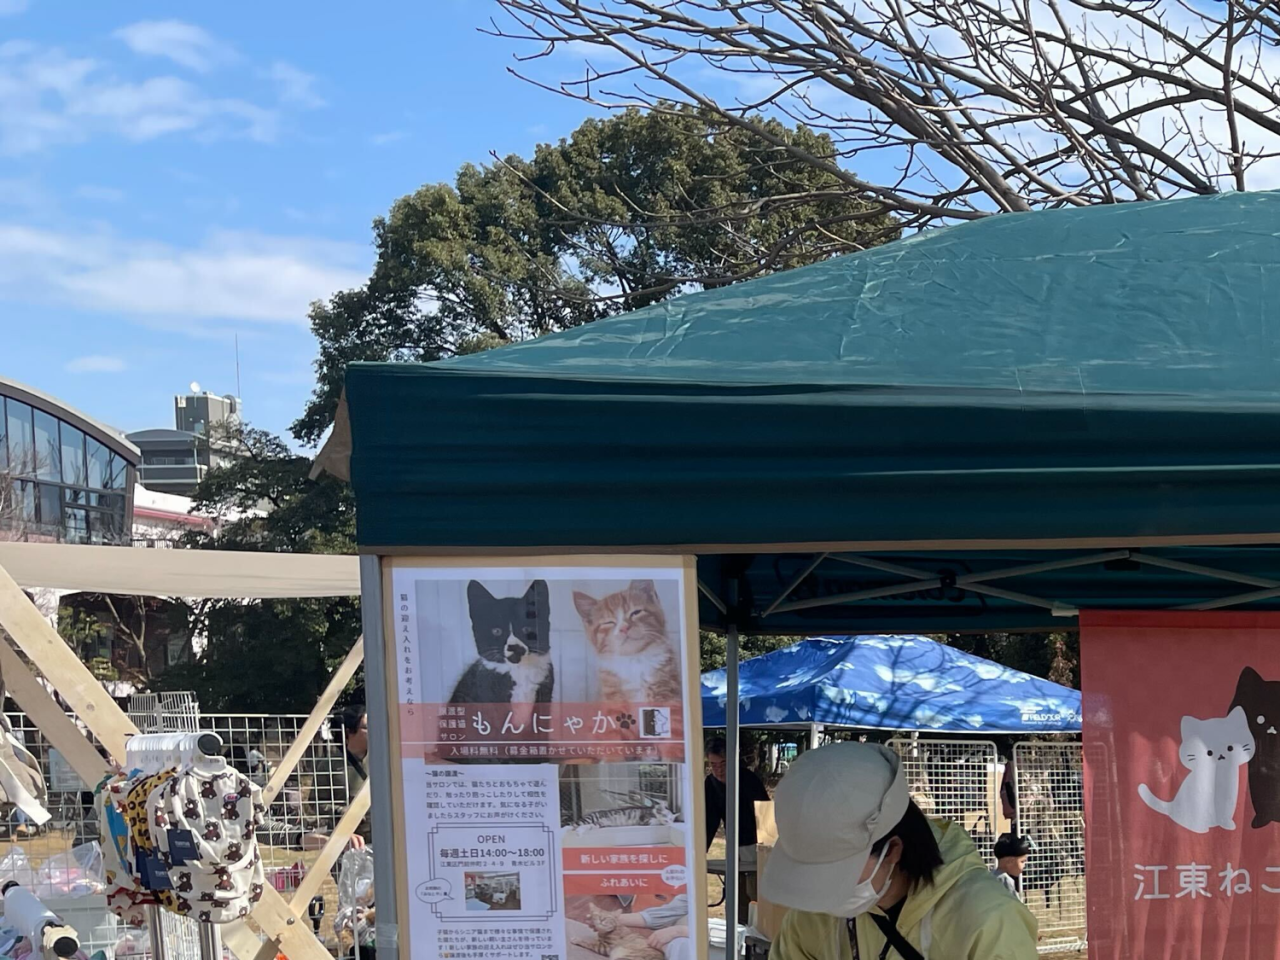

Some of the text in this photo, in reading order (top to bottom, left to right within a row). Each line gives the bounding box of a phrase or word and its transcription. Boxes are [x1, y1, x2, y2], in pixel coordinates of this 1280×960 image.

[400, 593, 415, 717] 猫の迎え入れをお考えなら
[472, 710, 616, 736] もんにゃか
[440, 733, 467, 741] サロン
[477, 834, 506, 844] OPEN
[440, 848, 545, 859] 毎週土日14:00～18:00
[600, 878, 648, 887] ふれあいに
